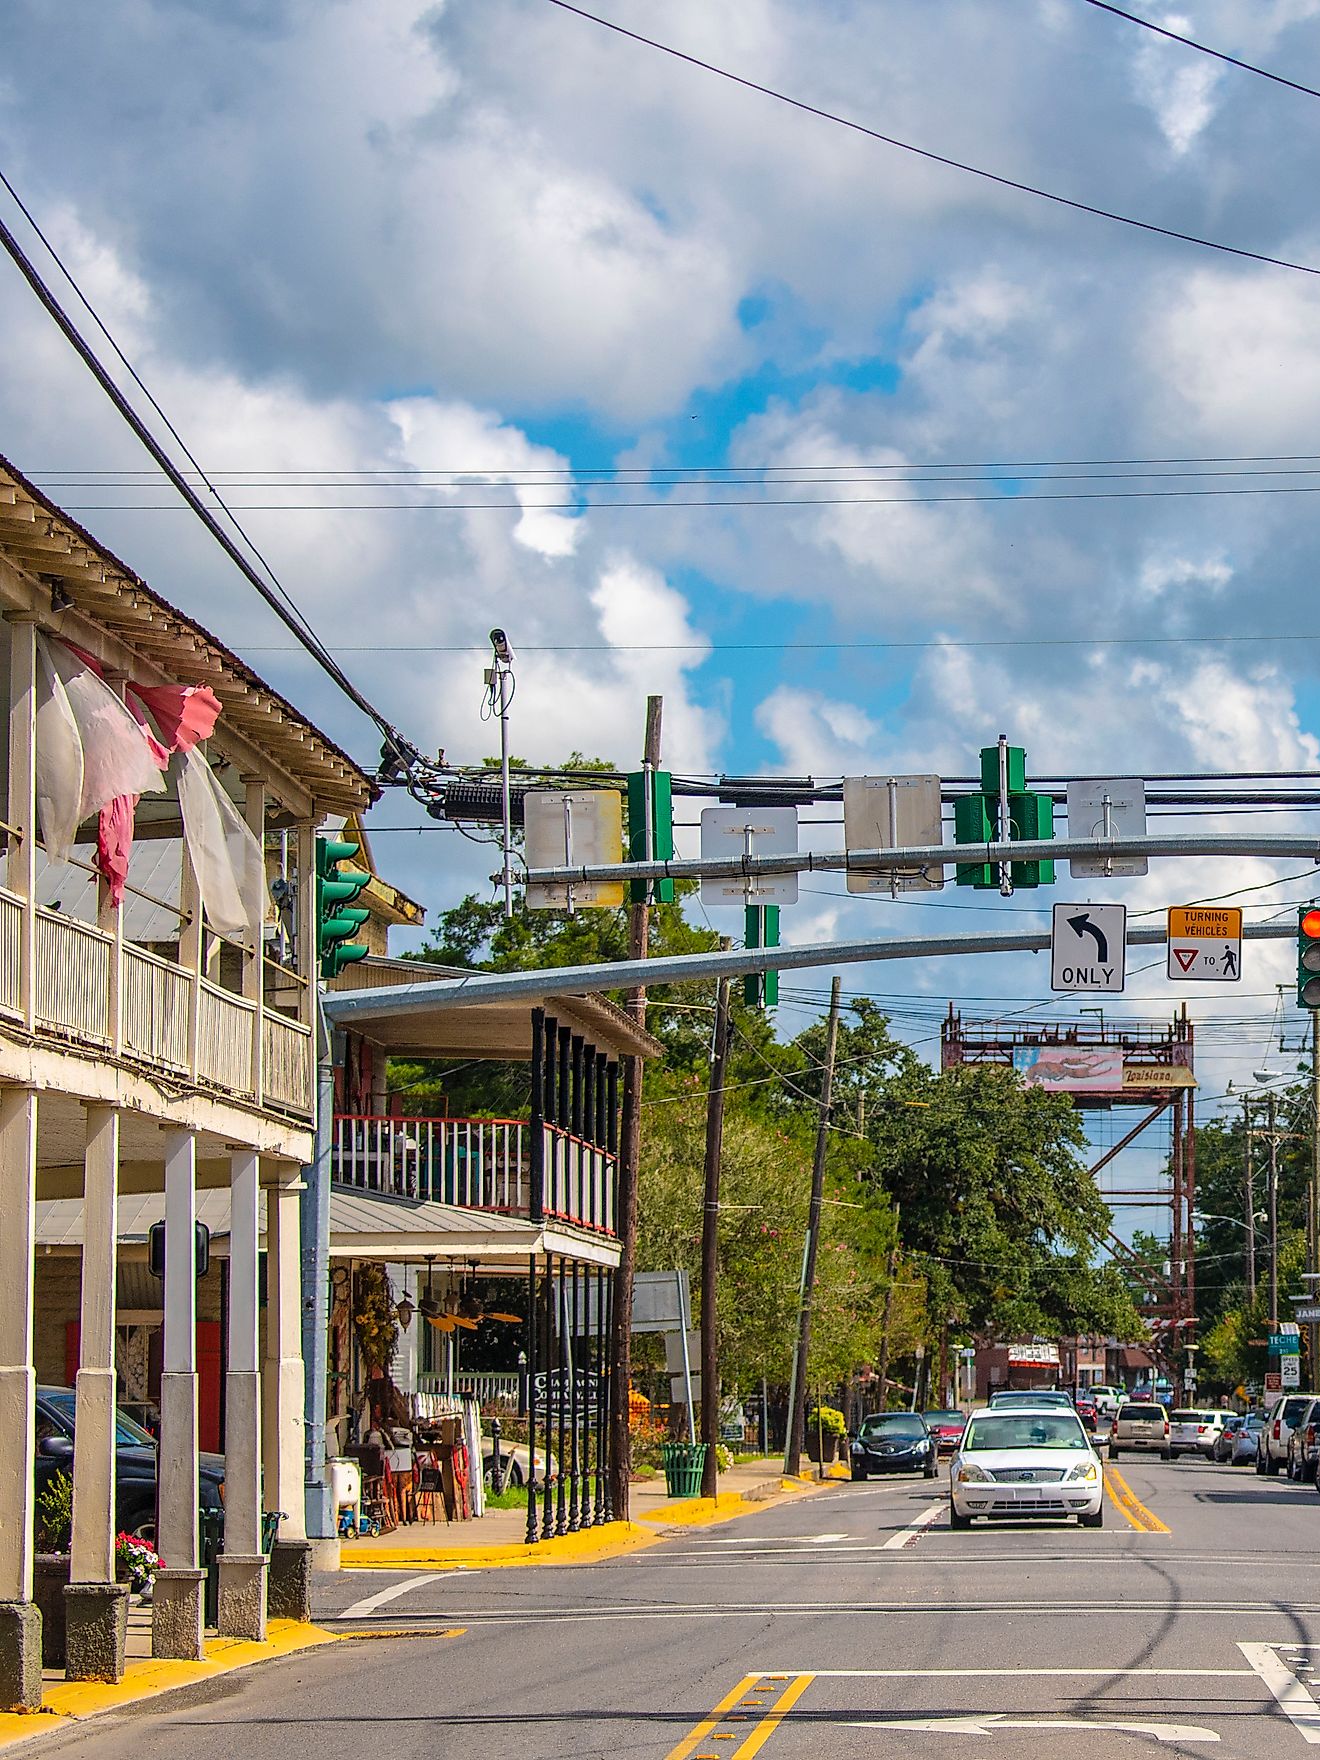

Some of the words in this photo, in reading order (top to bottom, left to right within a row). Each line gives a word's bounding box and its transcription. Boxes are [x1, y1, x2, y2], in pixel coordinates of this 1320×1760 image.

[1184, 911, 1229, 922] TURNING
[1184, 925, 1228, 936] VEHICLES
[1203, 957, 1216, 966] TO
[1062, 967, 1115, 985] ONLY
[1269, 1335, 1299, 1345] TECHE
[1283, 1366, 1298, 1376] 25
